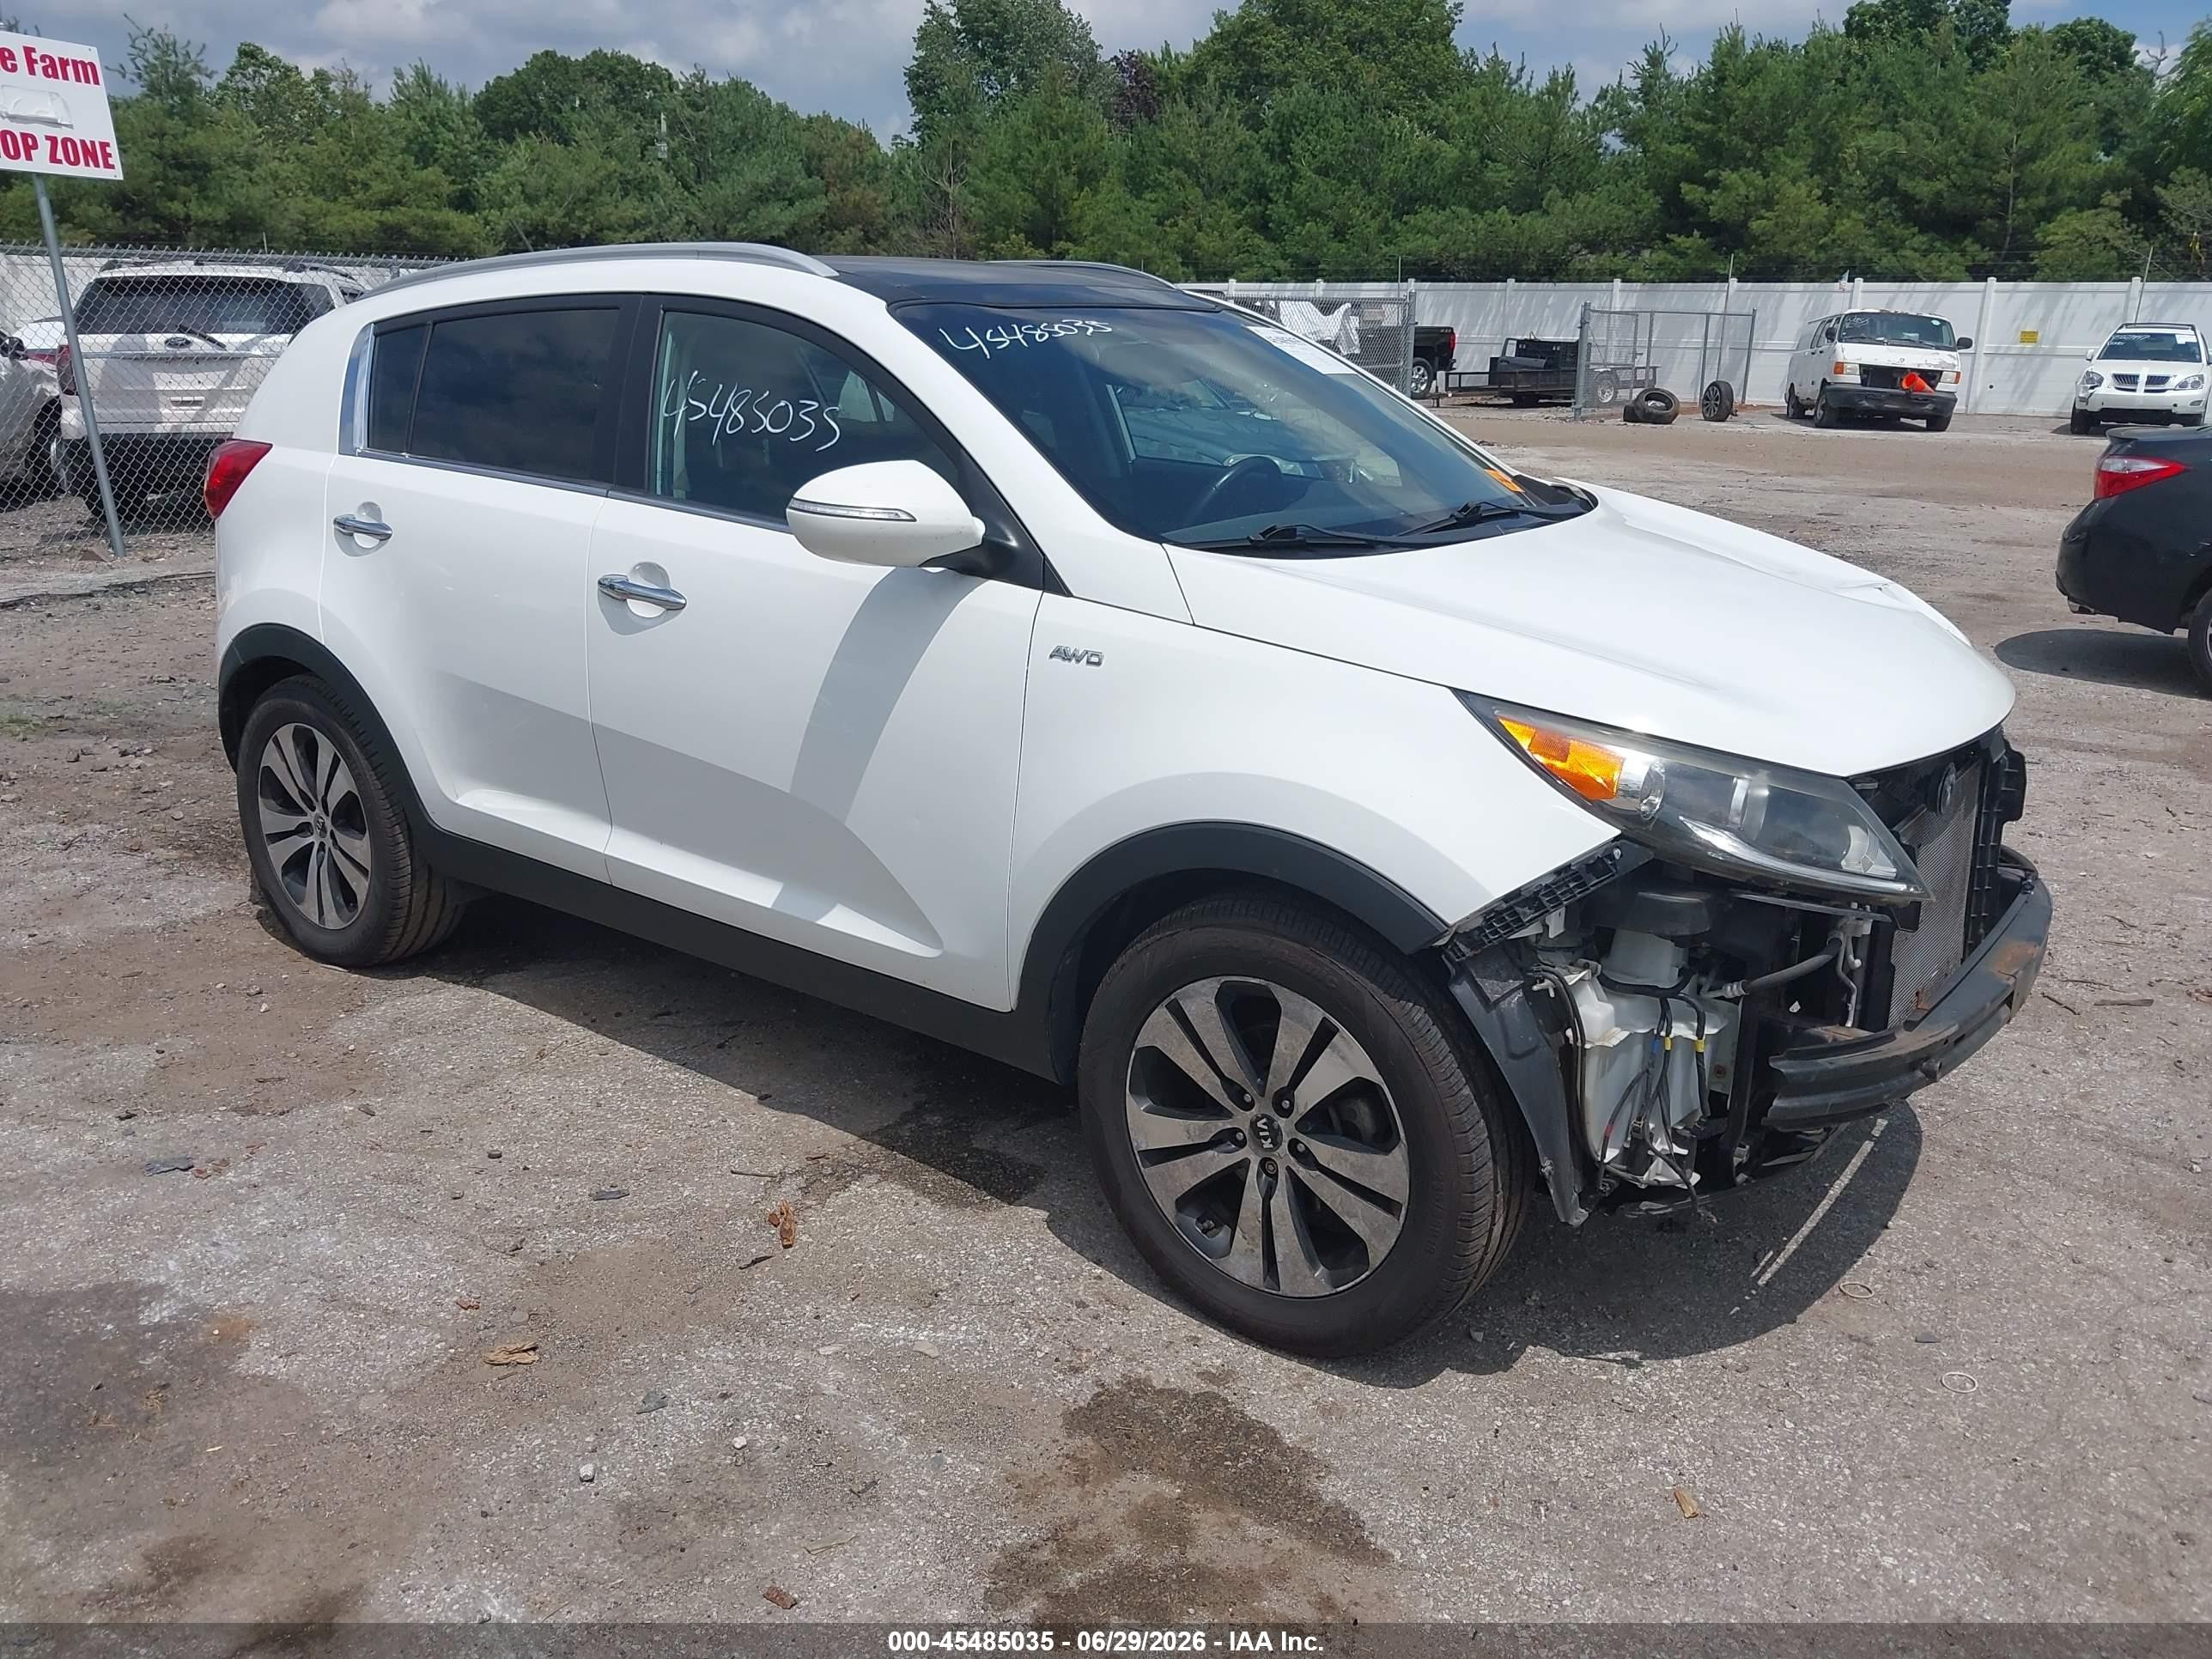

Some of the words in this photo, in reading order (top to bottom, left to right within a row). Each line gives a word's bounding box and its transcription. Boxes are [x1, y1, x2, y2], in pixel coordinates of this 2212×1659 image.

[22, 46, 100, 86] Farm
[0, 129, 39, 161] OP
[44, 135, 116, 170] ZONE
[939, 319, 1113, 359] 45485035
[662, 370, 840, 452] 45485035
[1048, 646, 1104, 667] AWD
[1256, 1118, 1274, 1149] KIA
